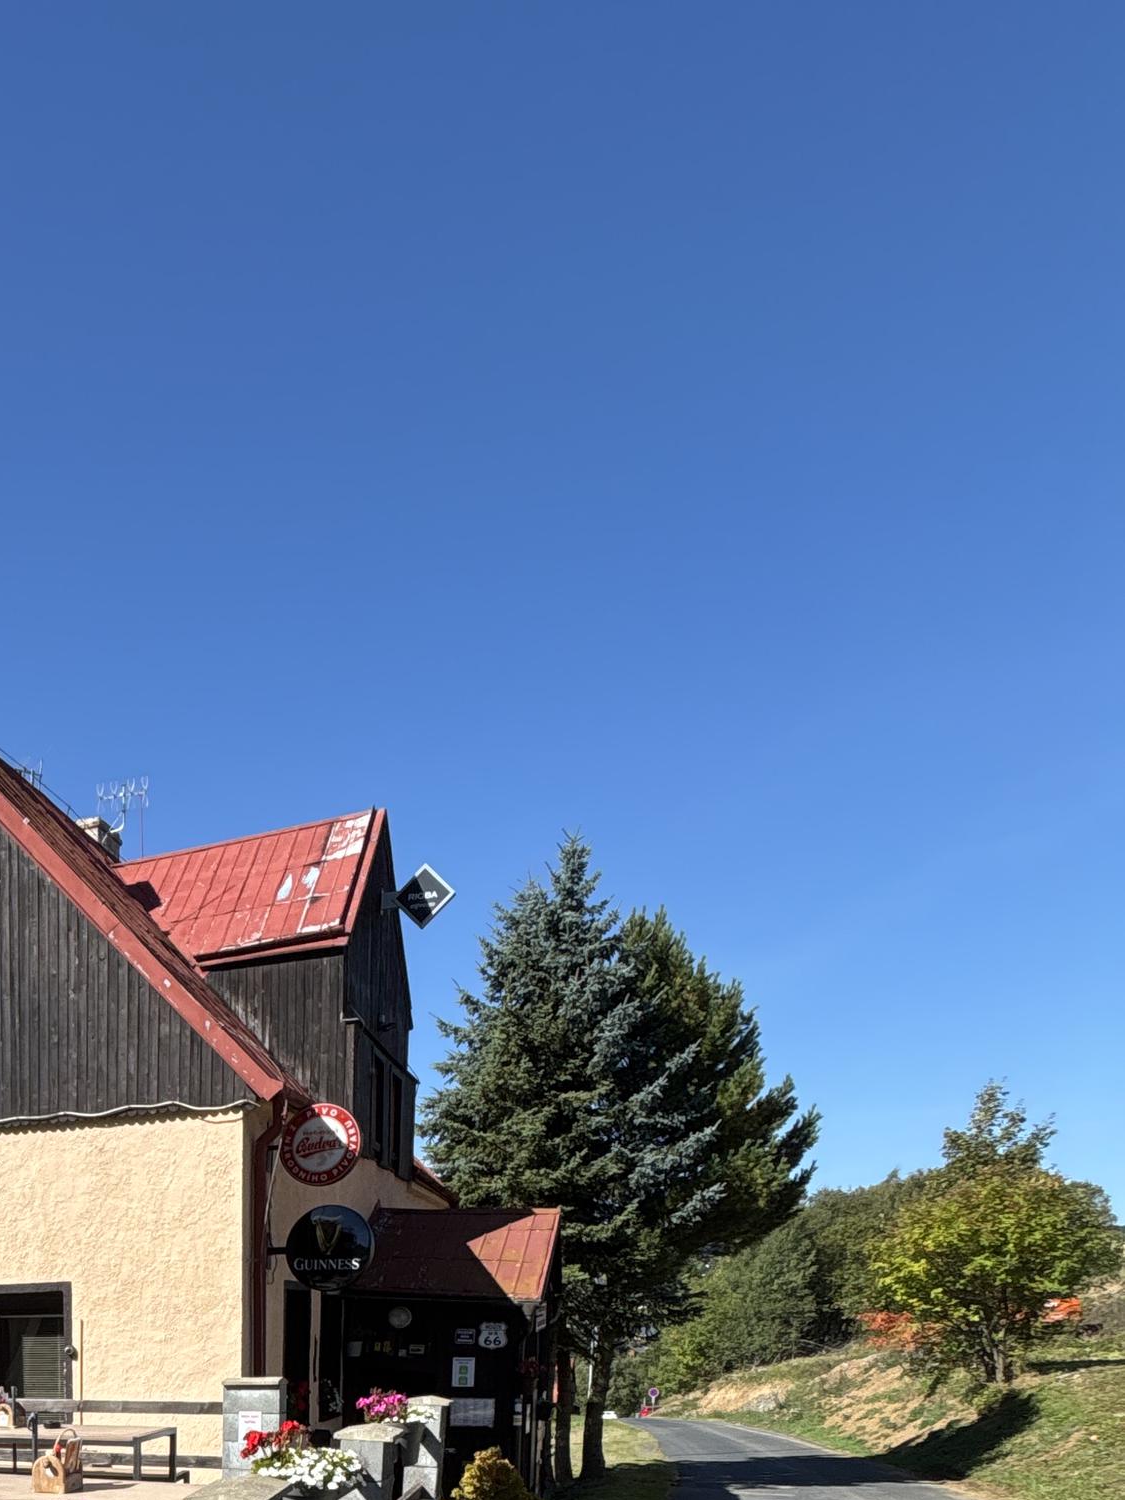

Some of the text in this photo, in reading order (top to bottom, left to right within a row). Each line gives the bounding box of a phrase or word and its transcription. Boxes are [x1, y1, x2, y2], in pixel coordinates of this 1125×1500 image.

[306, 1106, 338, 1119] PIVO
[293, 1258, 362, 1270] GUINNESS
[484, 1336, 501, 1346] 66
